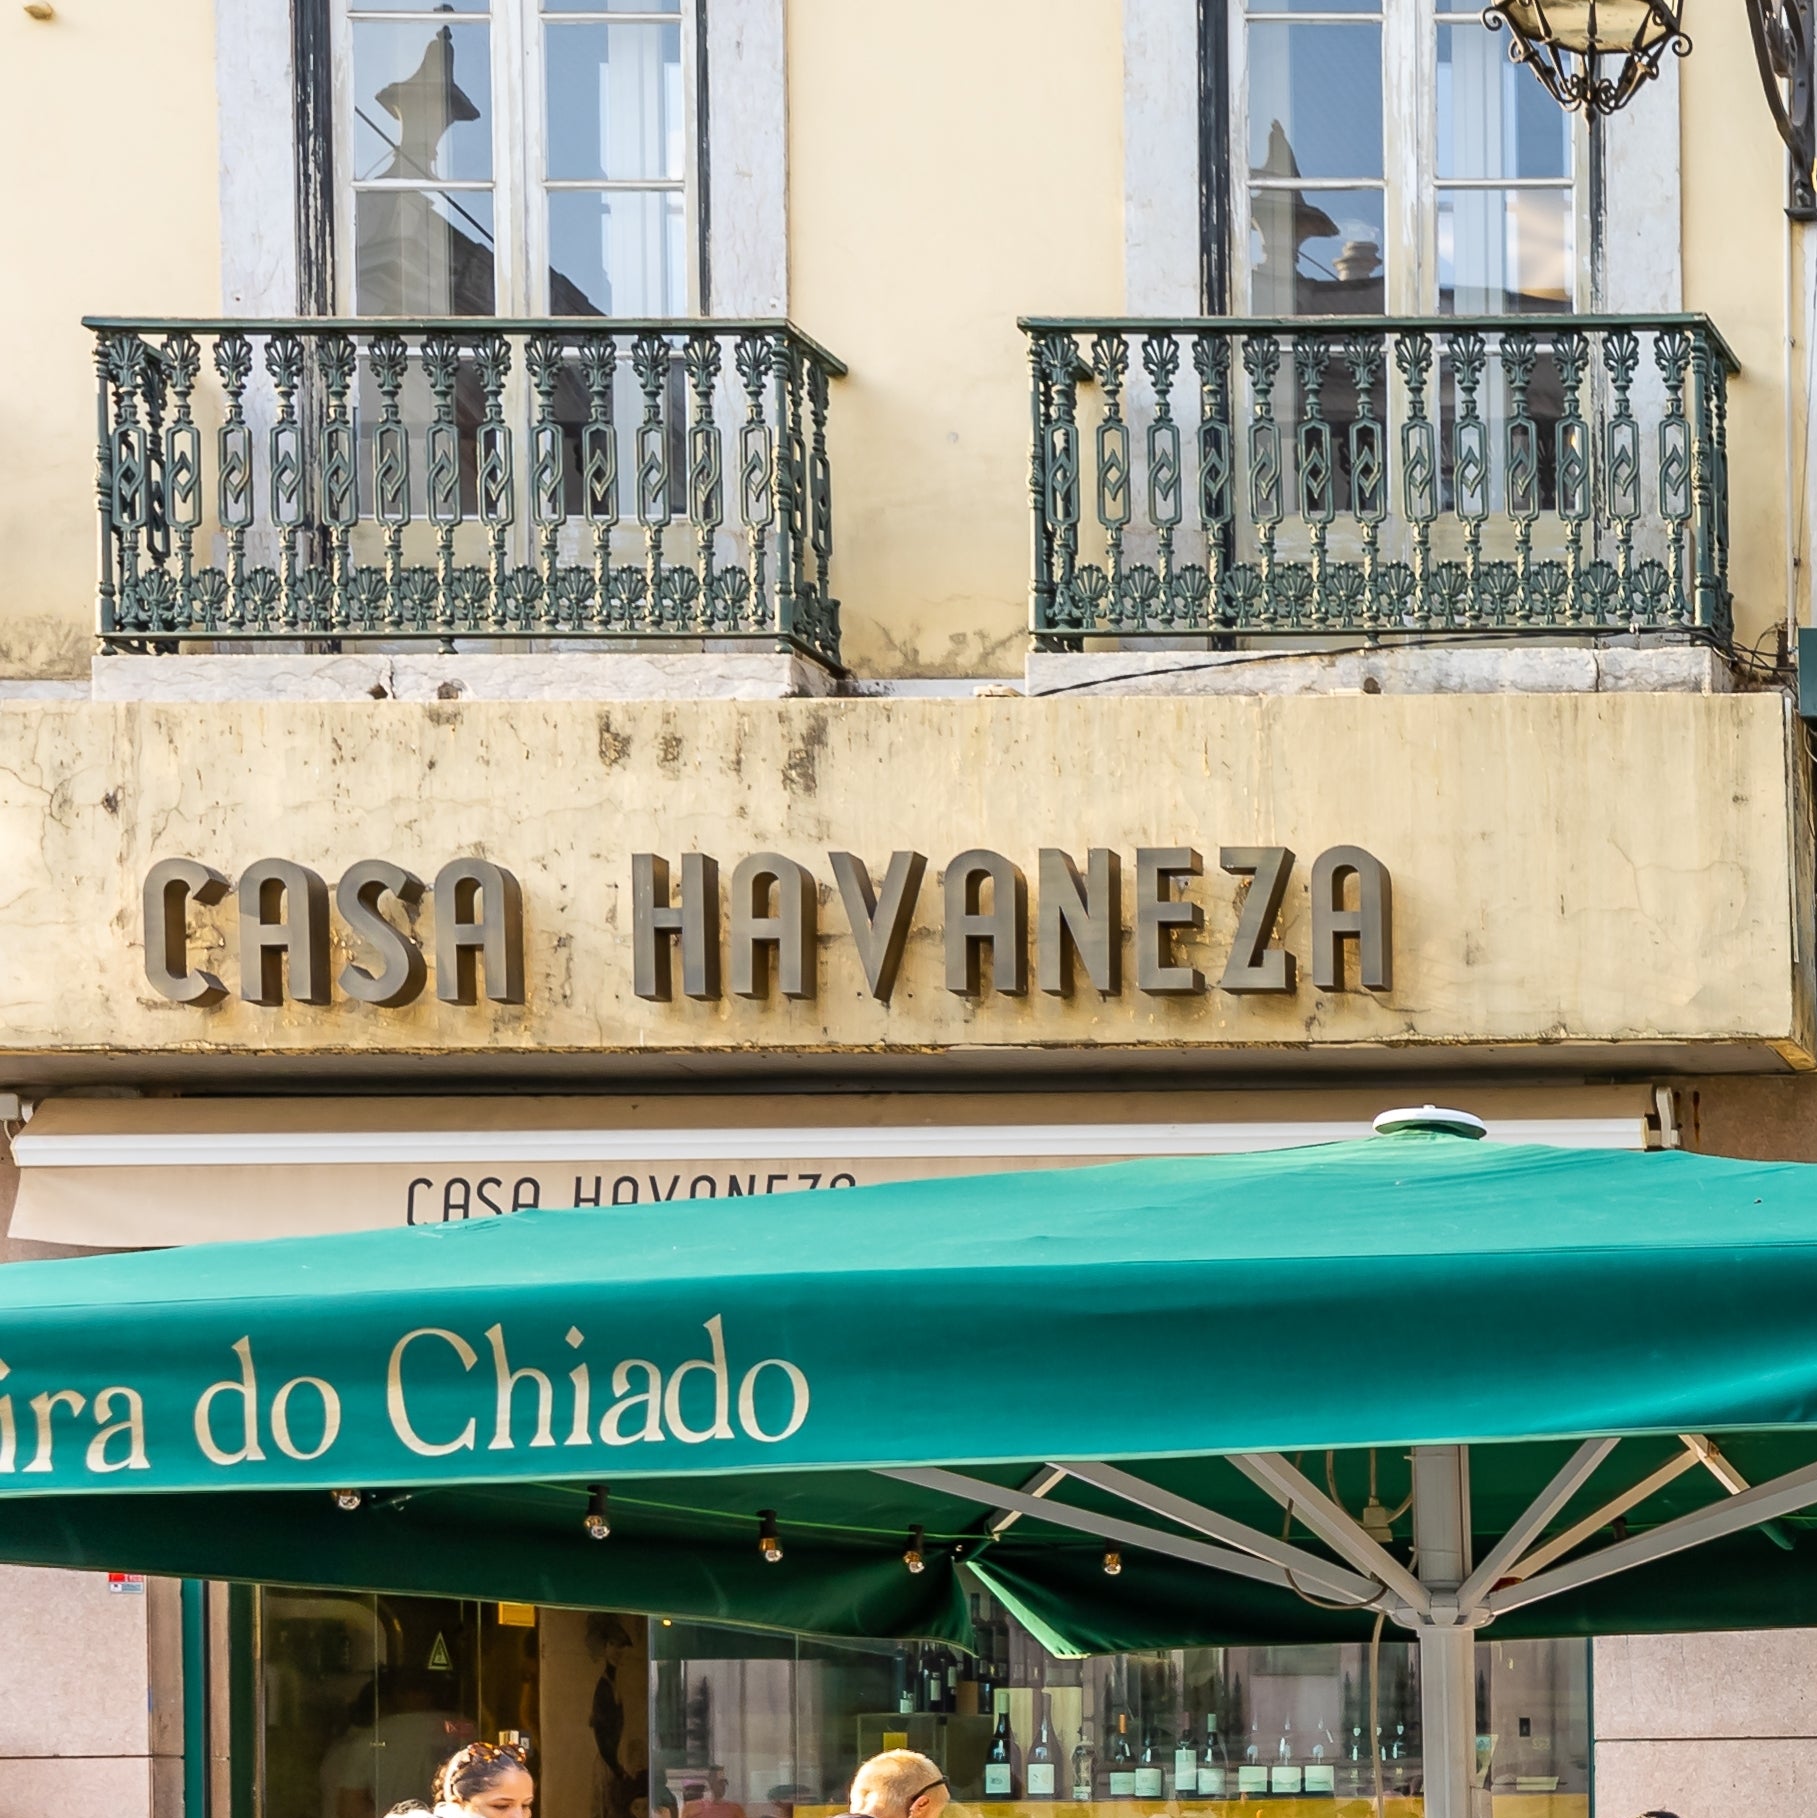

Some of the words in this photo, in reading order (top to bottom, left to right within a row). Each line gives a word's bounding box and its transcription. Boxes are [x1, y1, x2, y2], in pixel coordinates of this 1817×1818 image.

[143, 856, 524, 1008] CASA
[631, 845, 1393, 1002] HAVANEZA
[407, 1176, 540, 1226] CASA
[573, 1173, 856, 1208] HAVA
[194, 1335, 341, 1466] do
[388, 1313, 810, 1456] Chiado
